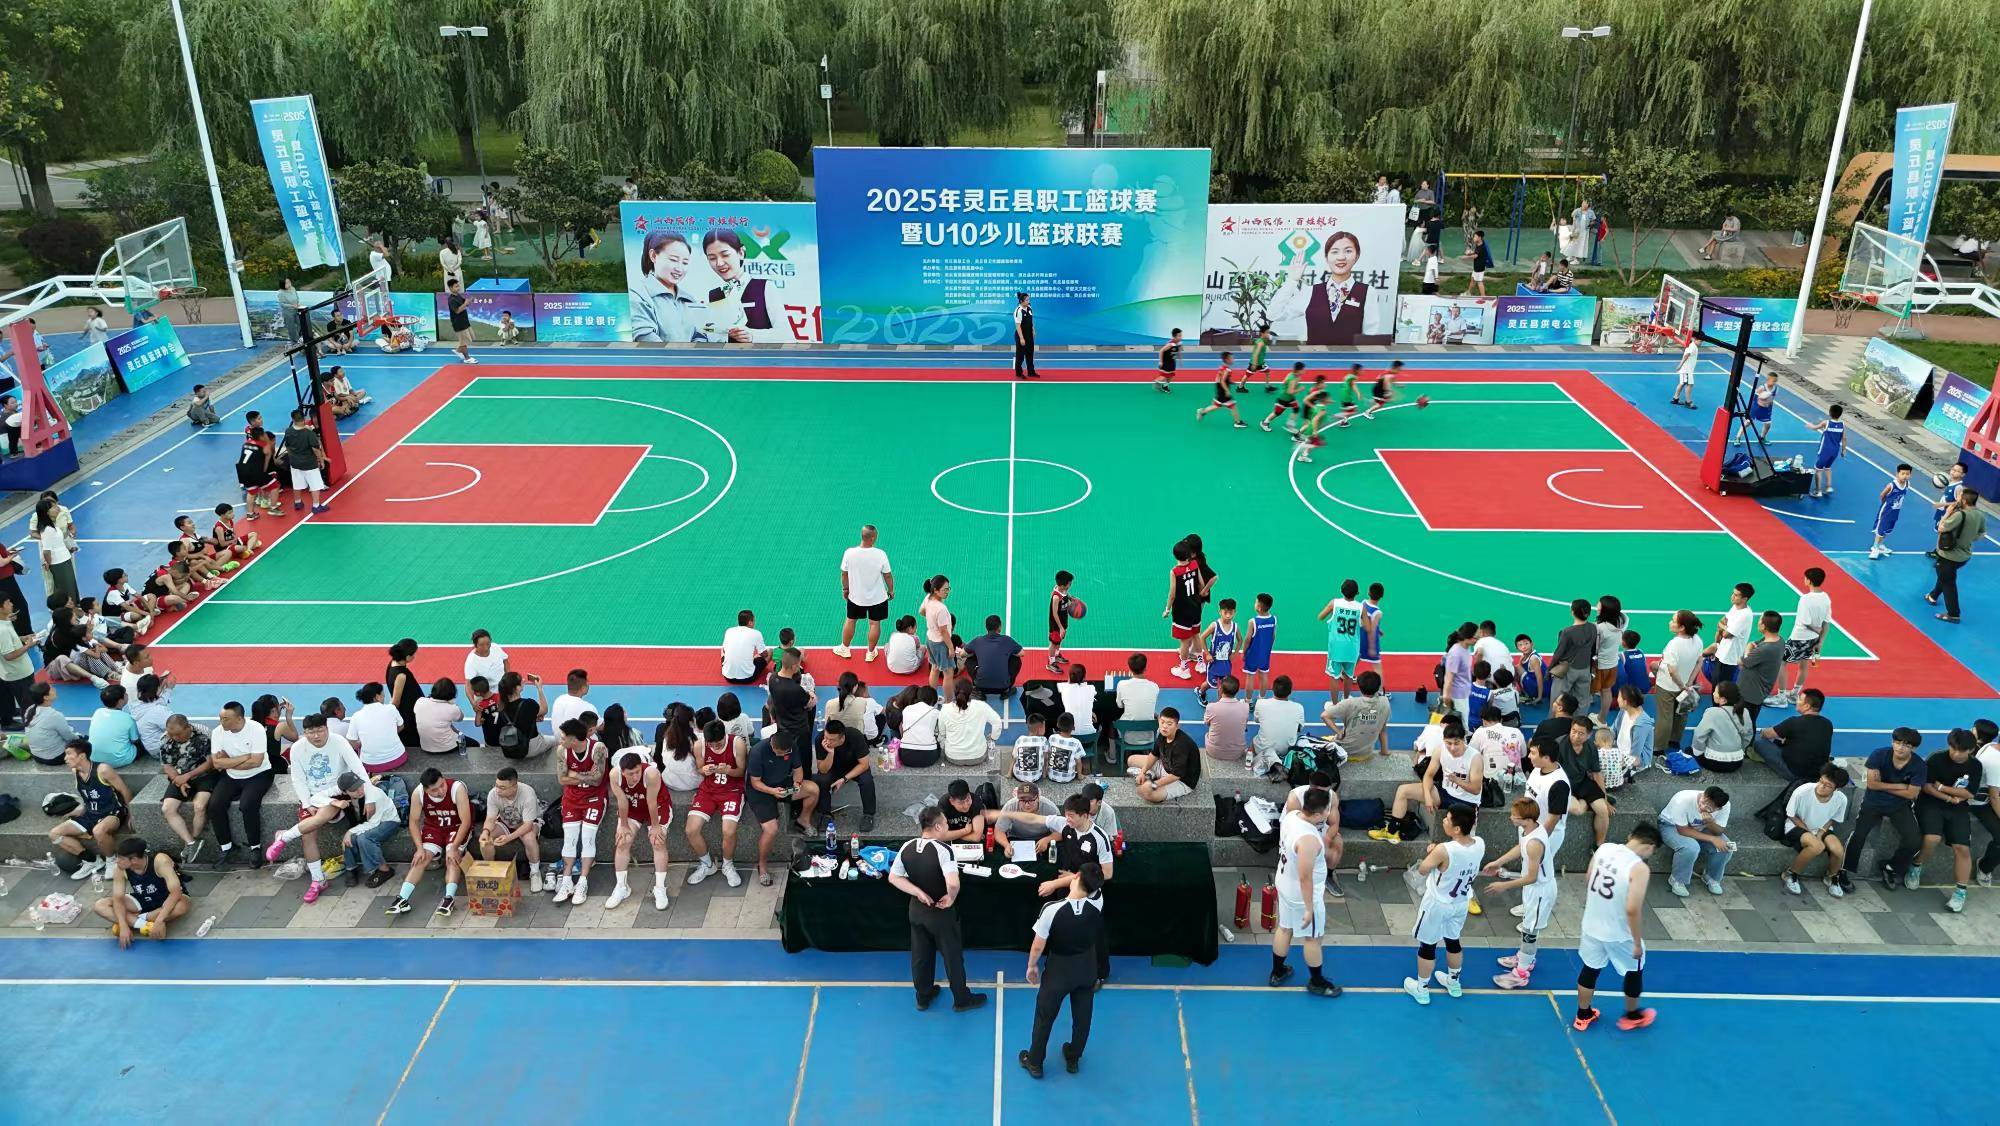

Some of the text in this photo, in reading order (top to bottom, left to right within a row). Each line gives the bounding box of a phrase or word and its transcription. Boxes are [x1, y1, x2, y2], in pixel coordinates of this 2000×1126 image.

[866, 188, 1158, 213] 2025年灵丘县职工篮球赛
[901, 222, 1123, 247] 暨U10少儿篮球联赛
[743, 262, 796, 277] 西农信
[543, 302, 563, 310] 2025
[1506, 305, 1526, 313] 2025
[552, 316, 617, 327] 灵丘建设银行
[832, 304, 1007, 344] 2025
[1508, 319, 1584, 329] 灵丘县供电公司
[1713, 321, 1792, 332] 平型关捷纪念馆
[117, 344, 132, 356] 2025
[243, 449, 254, 464] 7
[1184, 578, 1195, 597] 11
[1336, 616, 1358, 637] 38
[491, 711, 500, 725] 7
[723, 801, 737, 812] 35
[585, 807, 599, 821] 12
[438, 816, 452, 827] 77
[1590, 869, 1616, 900] 13
